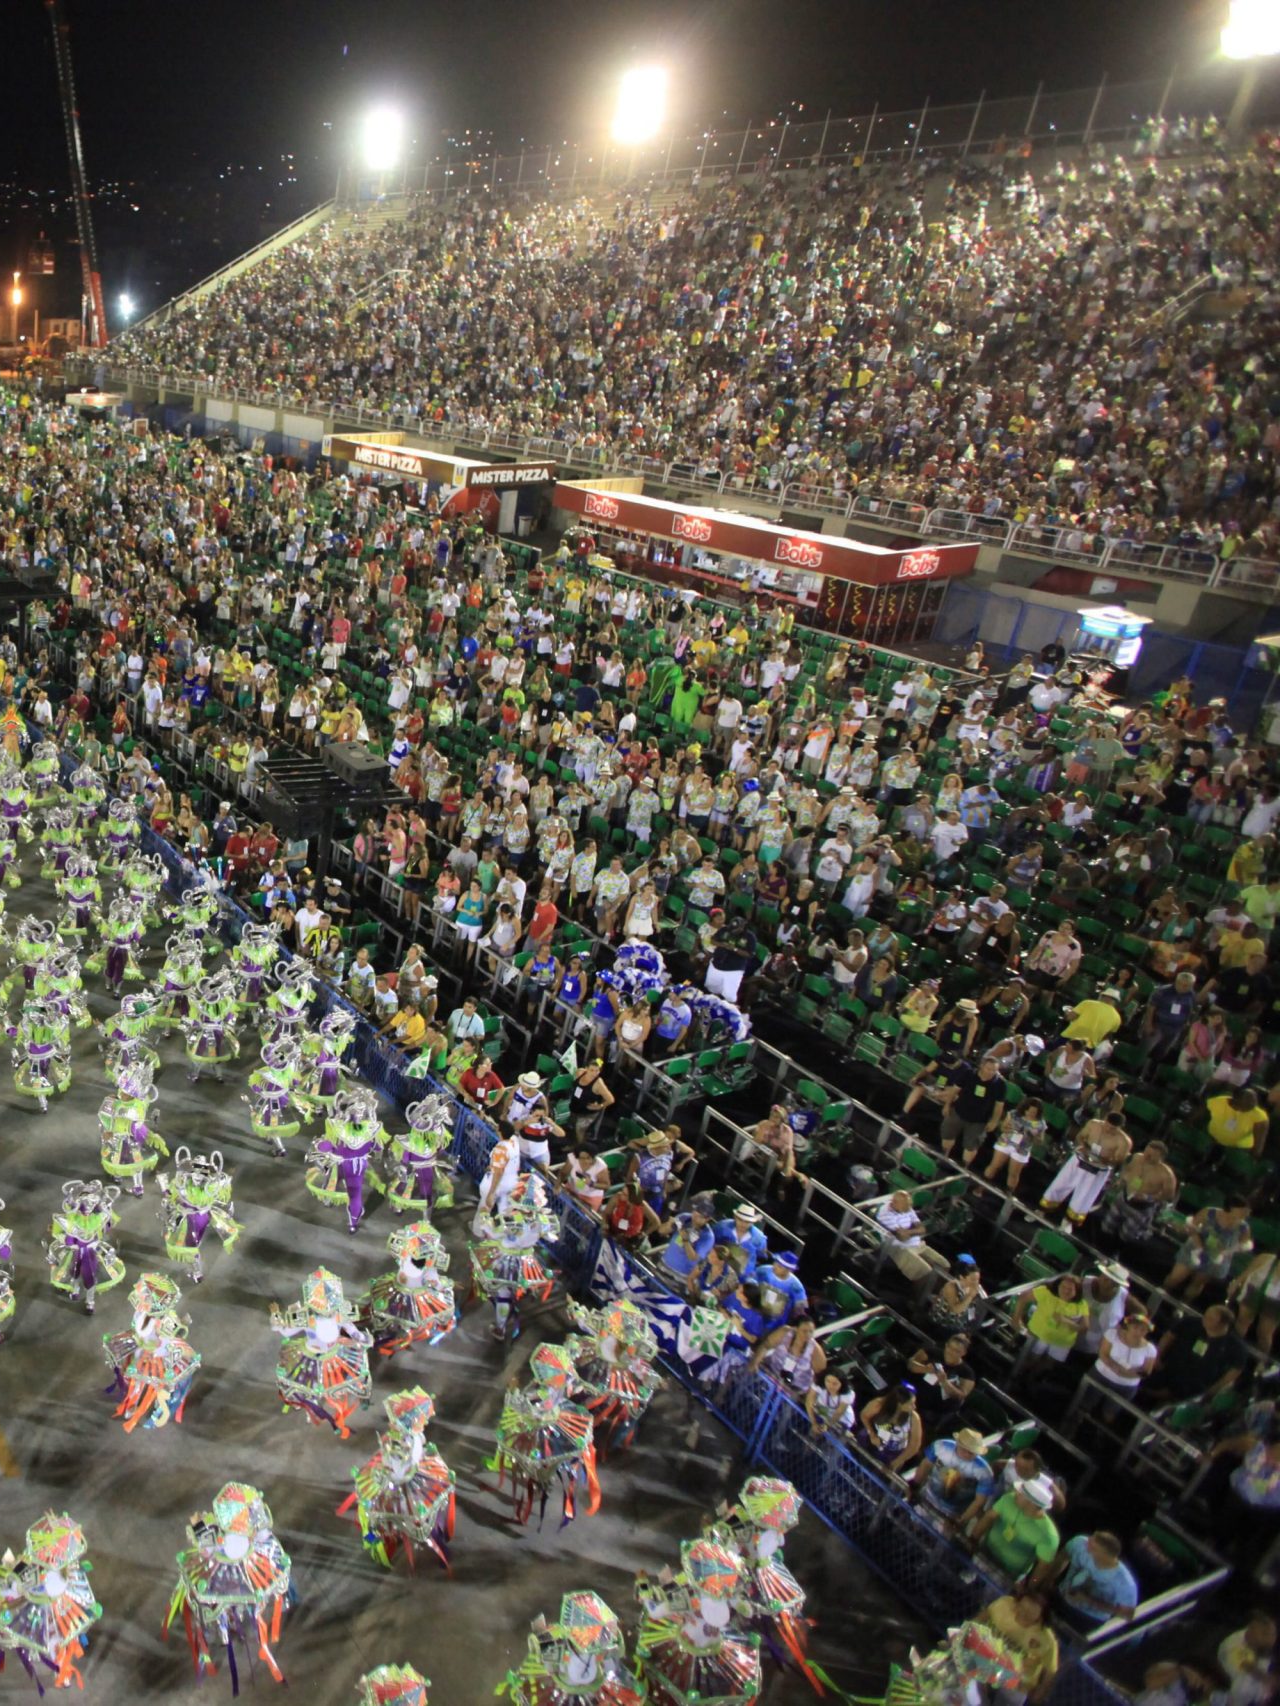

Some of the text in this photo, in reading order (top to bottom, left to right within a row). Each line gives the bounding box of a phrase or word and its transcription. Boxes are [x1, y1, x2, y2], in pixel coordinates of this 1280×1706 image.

[355, 447, 422, 475] MISTER PIZZA
[471, 468, 549, 484] MISTER PIZZA
[585, 494, 618, 519] Bob's
[673, 515, 712, 541] Bob's
[775, 538, 823, 567] Bob's
[897, 554, 939, 577] Bob's
